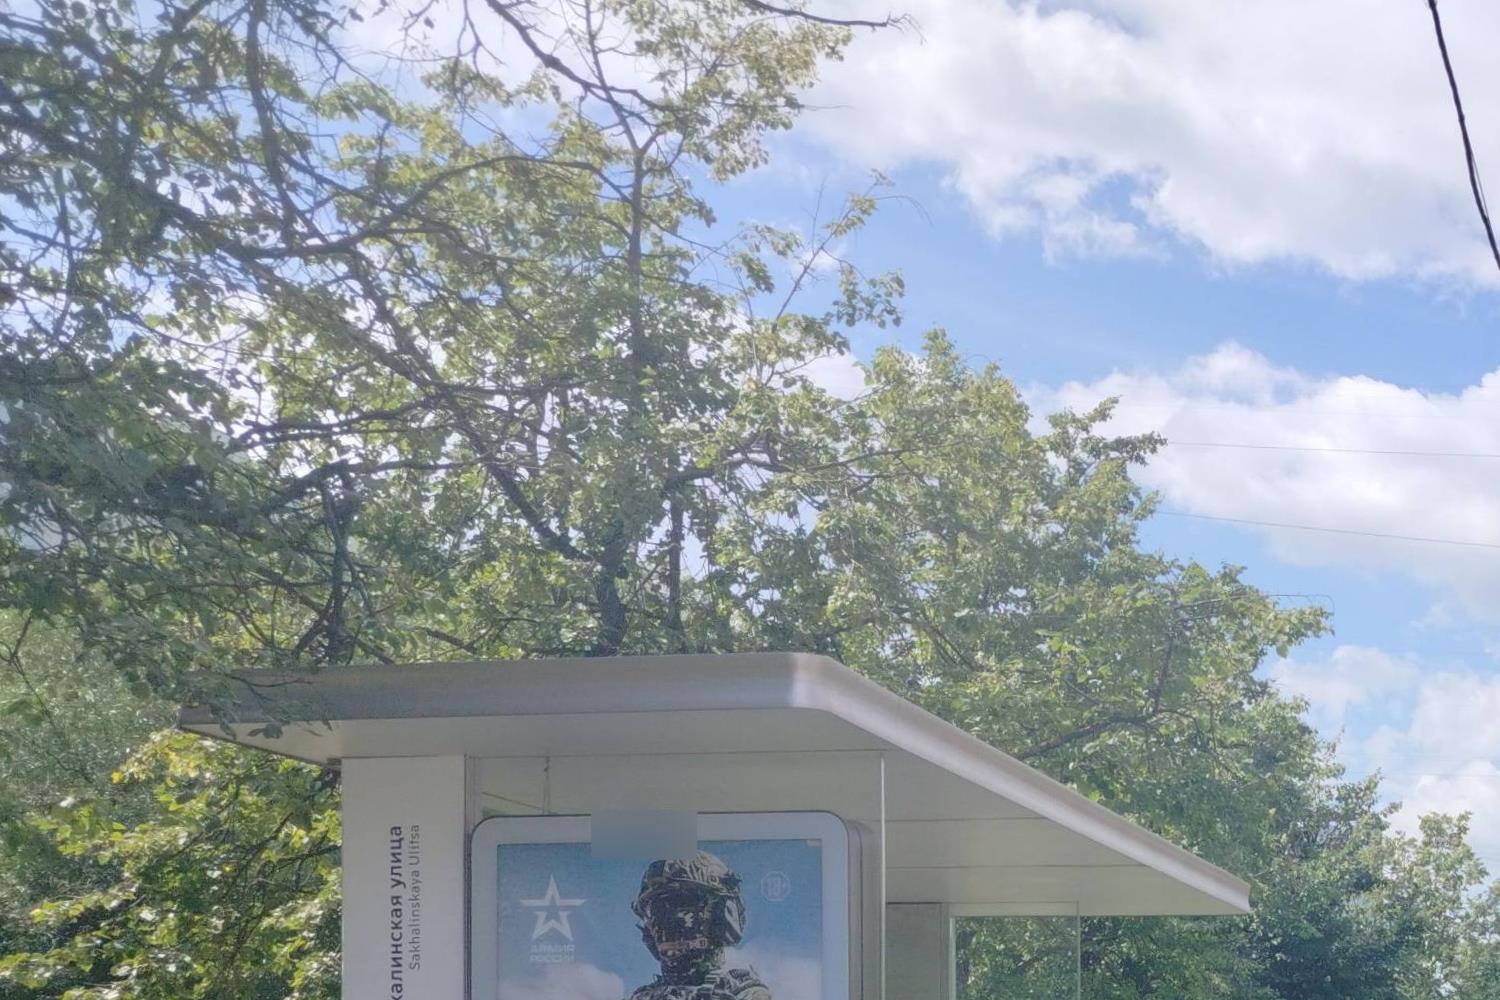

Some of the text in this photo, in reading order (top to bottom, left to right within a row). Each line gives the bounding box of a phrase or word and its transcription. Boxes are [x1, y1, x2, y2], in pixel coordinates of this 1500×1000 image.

[389, 825, 407, 889] улица
[408, 824, 422, 970] Sakhalinskaya Ulitsa
